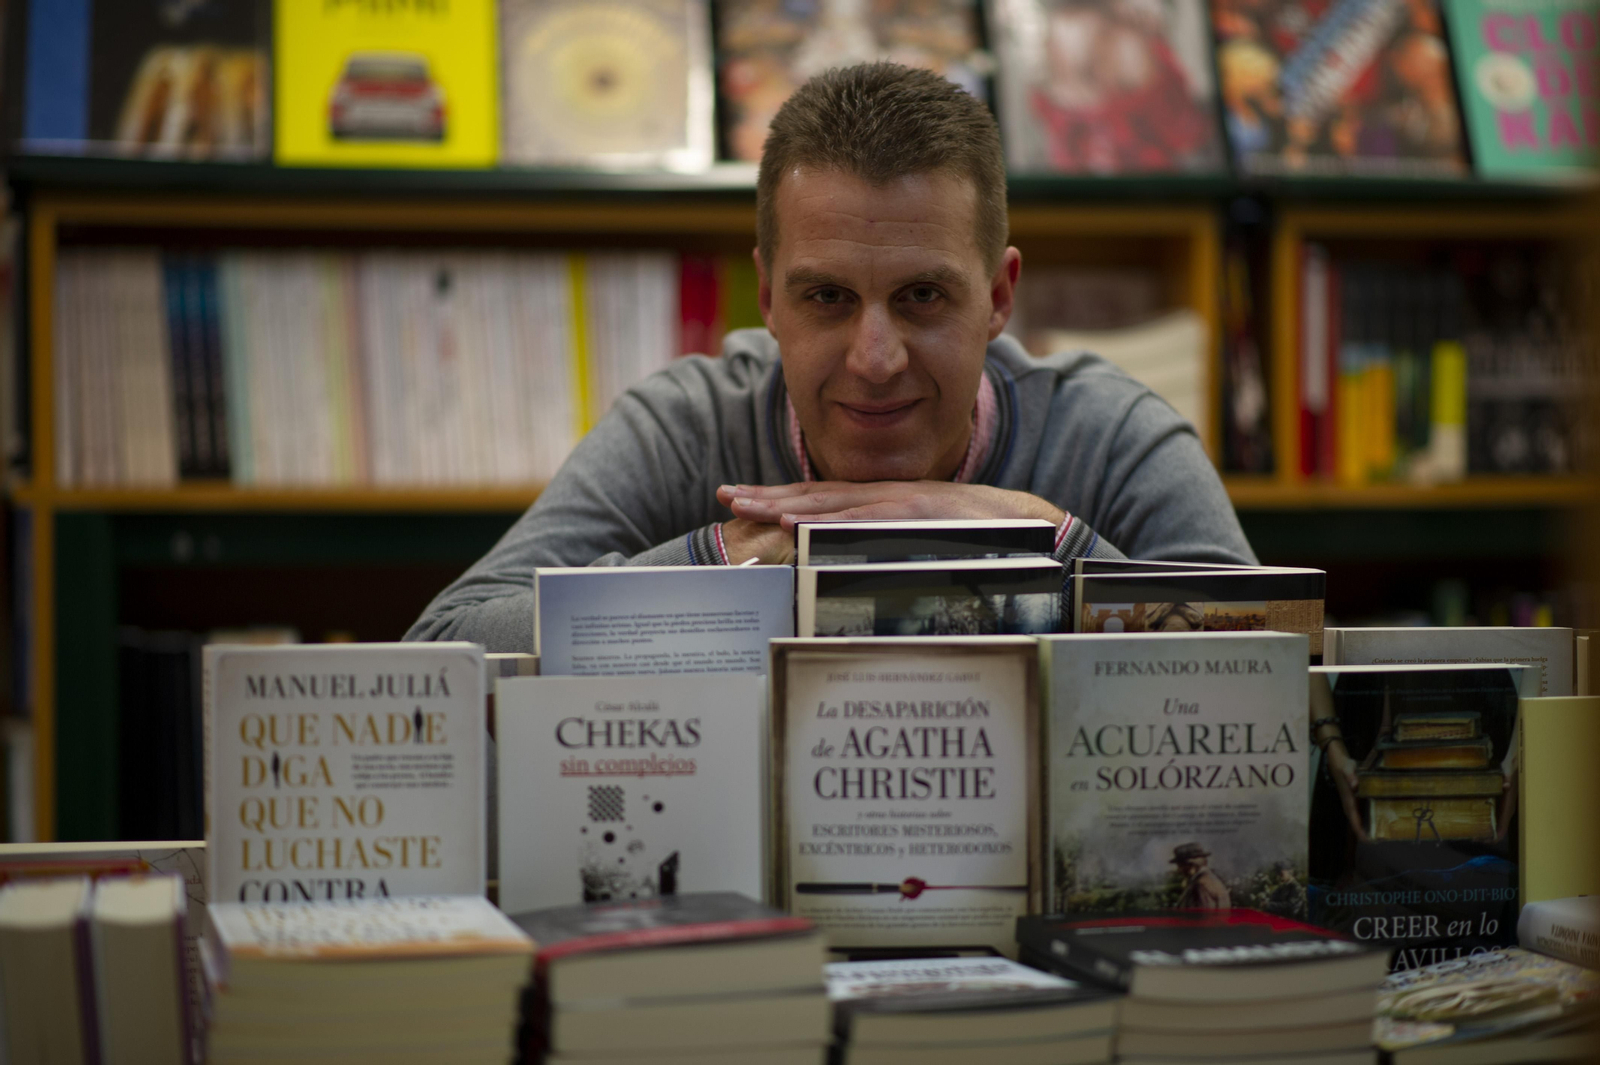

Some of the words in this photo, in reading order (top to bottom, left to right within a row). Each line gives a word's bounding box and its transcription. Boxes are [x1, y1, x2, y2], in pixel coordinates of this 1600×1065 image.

[1094, 659, 1199, 676] FERNANDO
[1204, 657, 1273, 675] MAURA
[244, 674, 364, 699] MANUEL
[370, 668, 450, 698] JULIÁ
[816, 701, 838, 718] La
[844, 697, 990, 718] DESAPARICIÓN
[1163, 698, 1199, 715] Una
[240, 712, 320, 750] QUE
[332, 705, 447, 745] NADIE
[555, 717, 702, 748] CHEKAS
[812, 738, 835, 758] de
[840, 726, 994, 758] AGATHA
[1066, 722, 1299, 758] ACUARELA
[241, 751, 334, 789] DIGA
[560, 754, 588, 772] sin
[594, 752, 697, 777] complejos
[1070, 780, 1089, 792] en
[1096, 759, 1294, 791] SOLÓRZANO
[814, 766, 996, 800] CHRISTIE
[240, 797, 319, 834] QUE
[332, 795, 385, 828] NO
[812, 824, 899, 837] ESCRITORES
[902, 823, 999, 838] MISTERIOSOS,
[240, 836, 442, 872] LUCHASTE
[799, 840, 896, 856] EXCÉNTRICOS
[908, 841, 1013, 856] HETERODOXOS
[1325, 890, 1420, 906] CHRISTOPHE
[1353, 915, 1440, 940] CREER
[1446, 920, 1472, 936] en
[1480, 912, 1499, 935] lo
